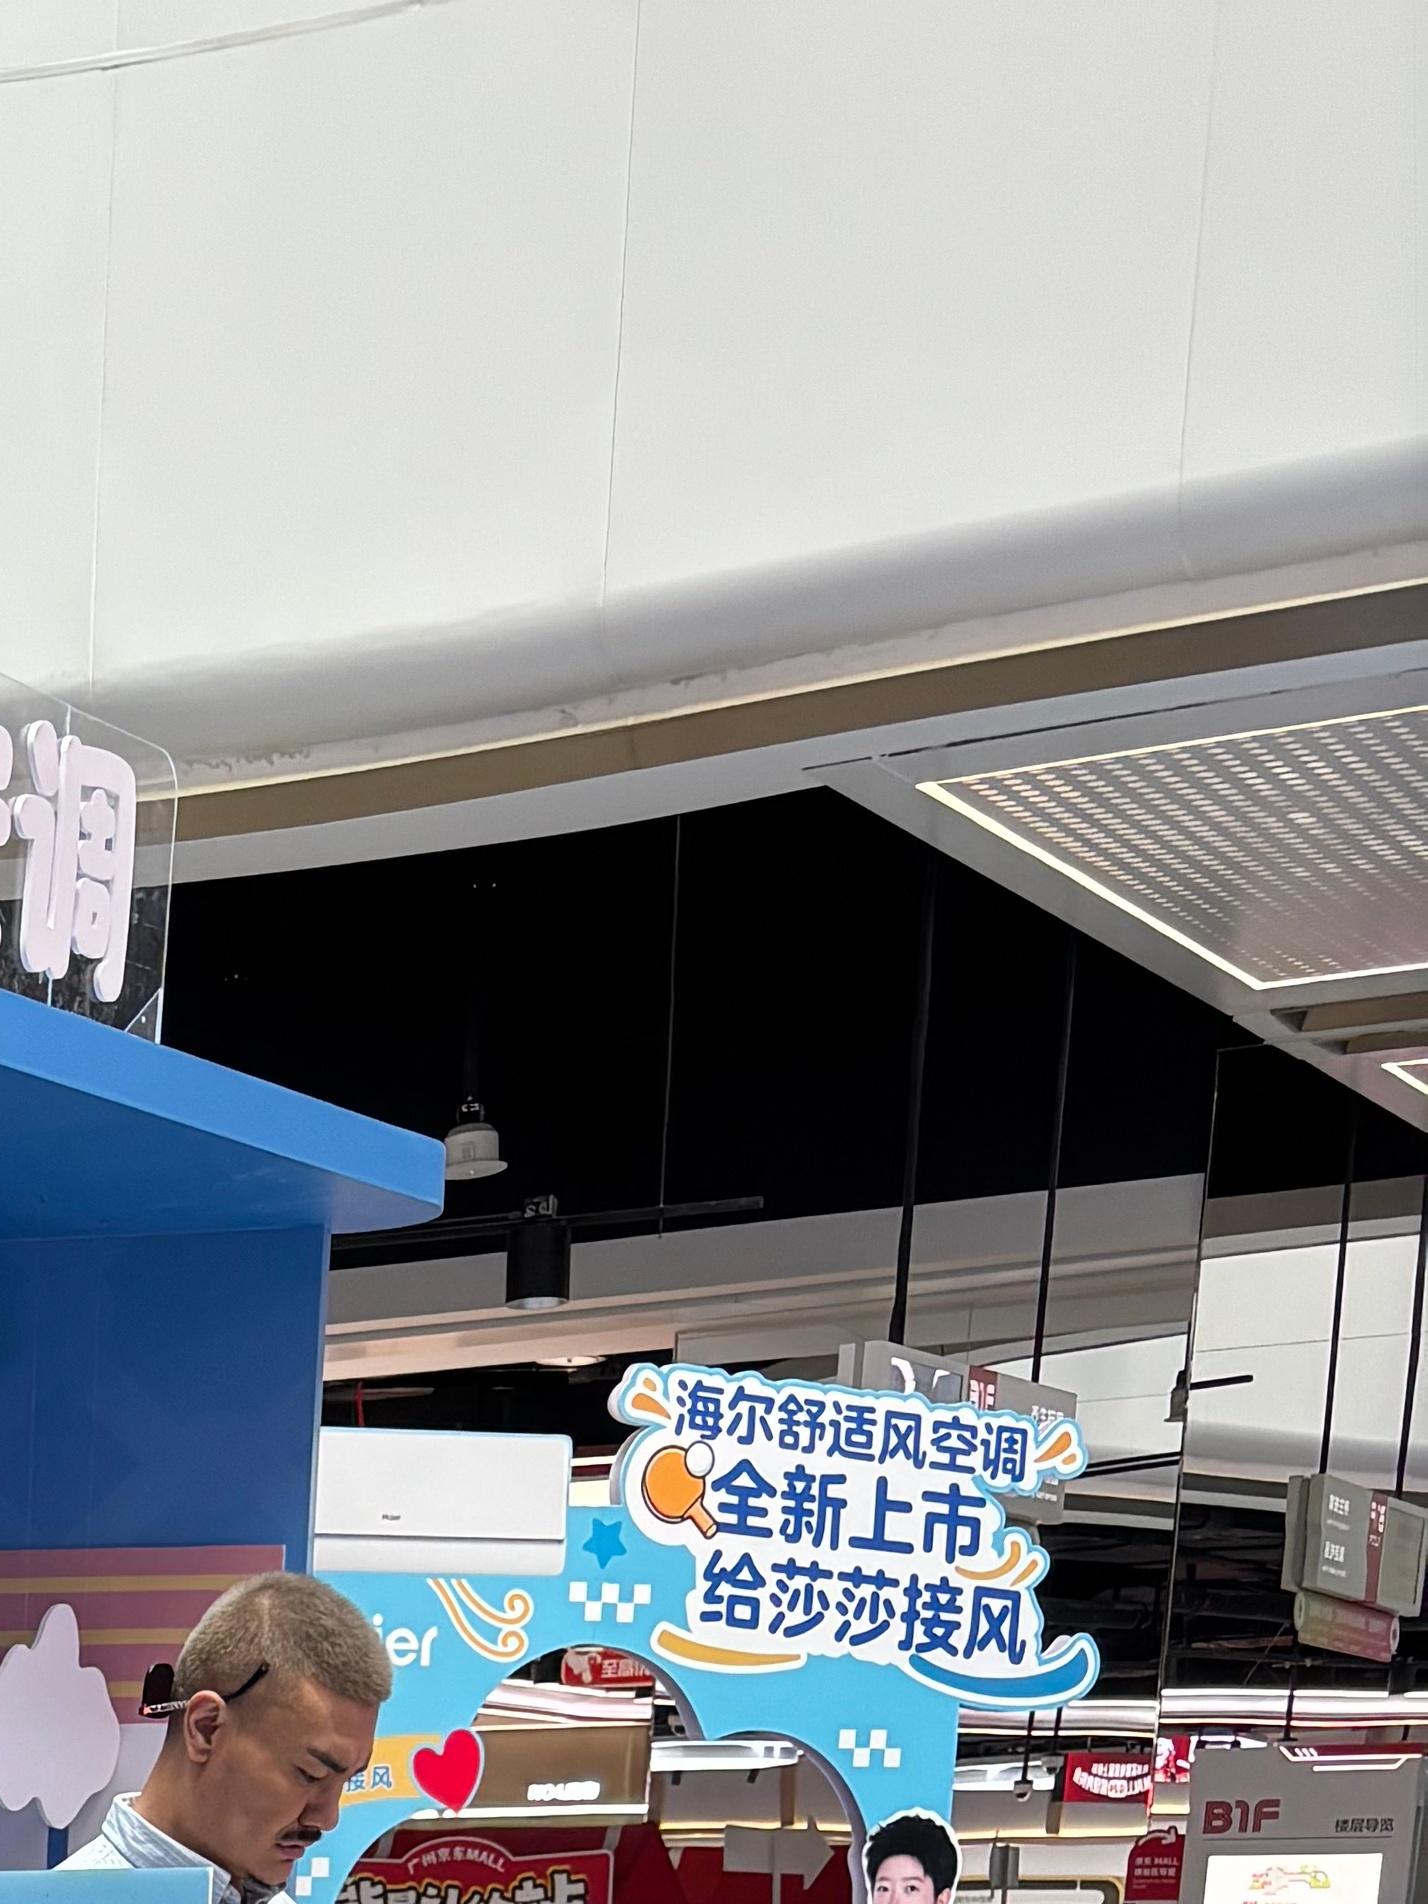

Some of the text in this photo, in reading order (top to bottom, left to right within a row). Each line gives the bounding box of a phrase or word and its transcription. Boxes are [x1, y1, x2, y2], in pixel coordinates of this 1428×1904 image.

[674, 1378, 1028, 1483] 海尔舒适风空调
[710, 1458, 986, 1565] 全新上市
[699, 1549, 1027, 1666] 给莎莎接风
[1202, 1799, 1281, 1834] B1F
[1335, 1818, 1394, 1833] 楼层导览
